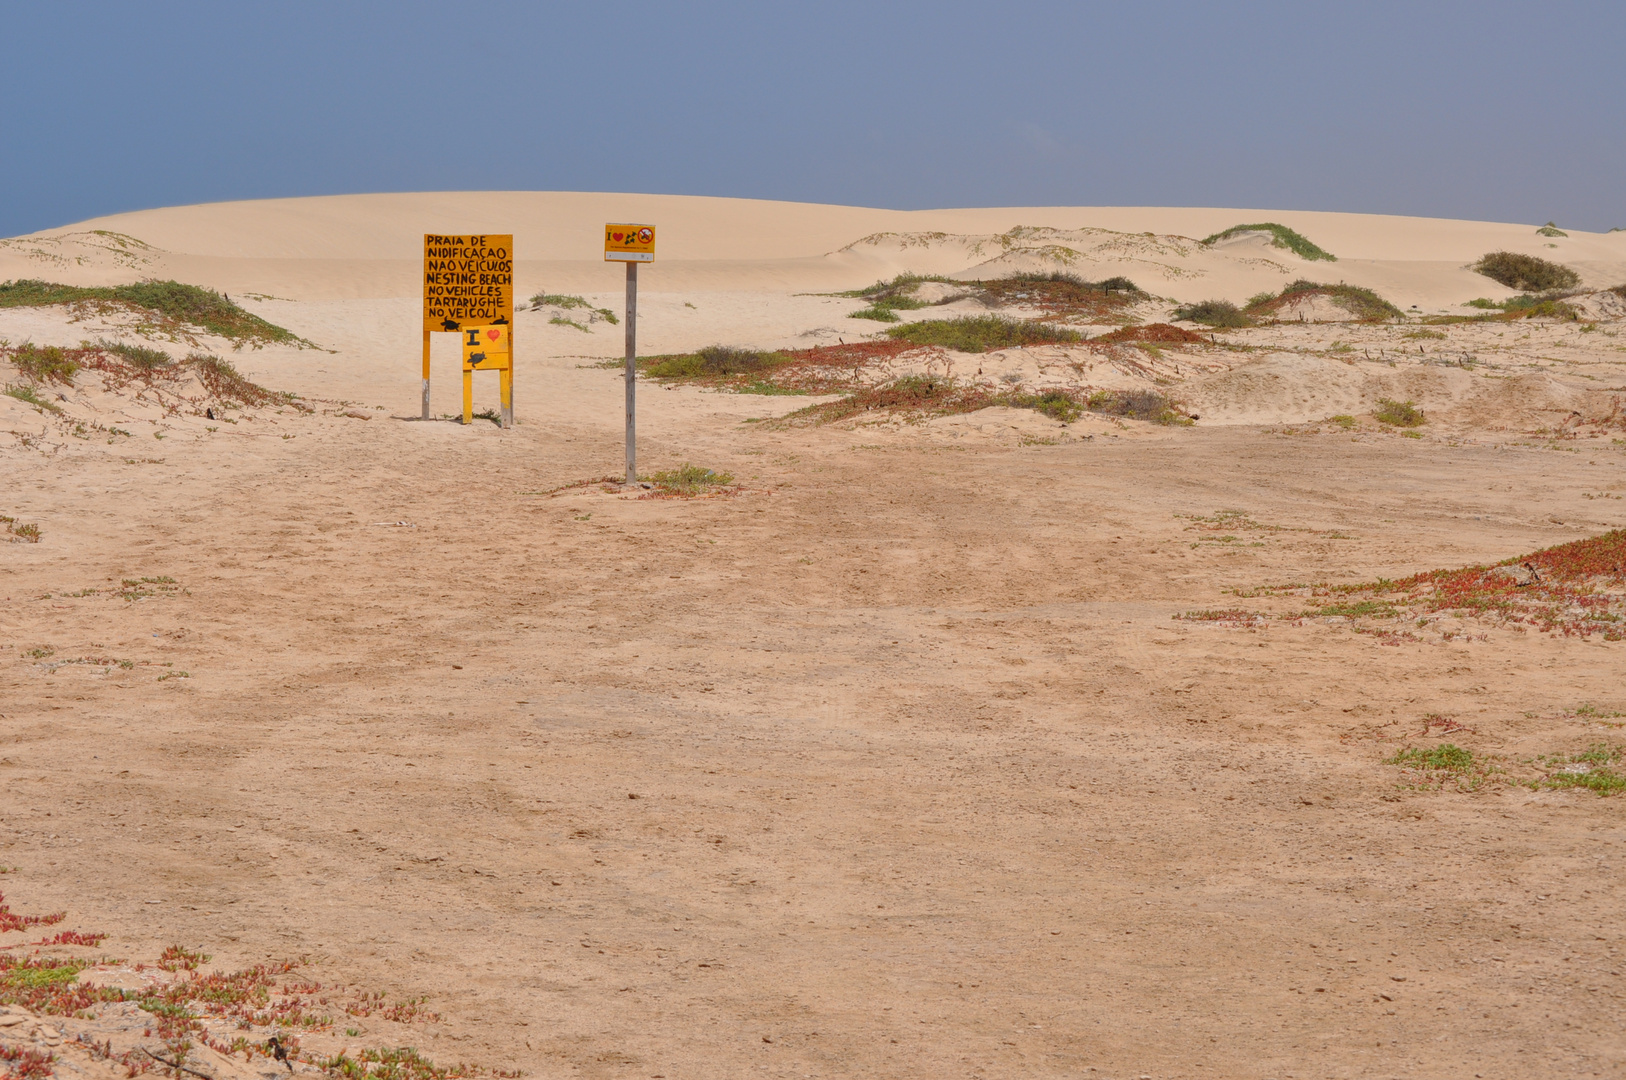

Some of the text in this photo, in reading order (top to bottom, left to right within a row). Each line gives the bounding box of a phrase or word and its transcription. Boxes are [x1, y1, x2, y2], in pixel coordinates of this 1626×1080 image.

[427, 235, 487, 247] PRAIA DE
[426, 272, 512, 286] NESTING BEACH
[428, 285, 502, 297] NO VEHICLES
[426, 296, 506, 308] TARTARUGHE
[428, 307, 497, 318] NO VEICOLI
[466, 329, 480, 346] I
